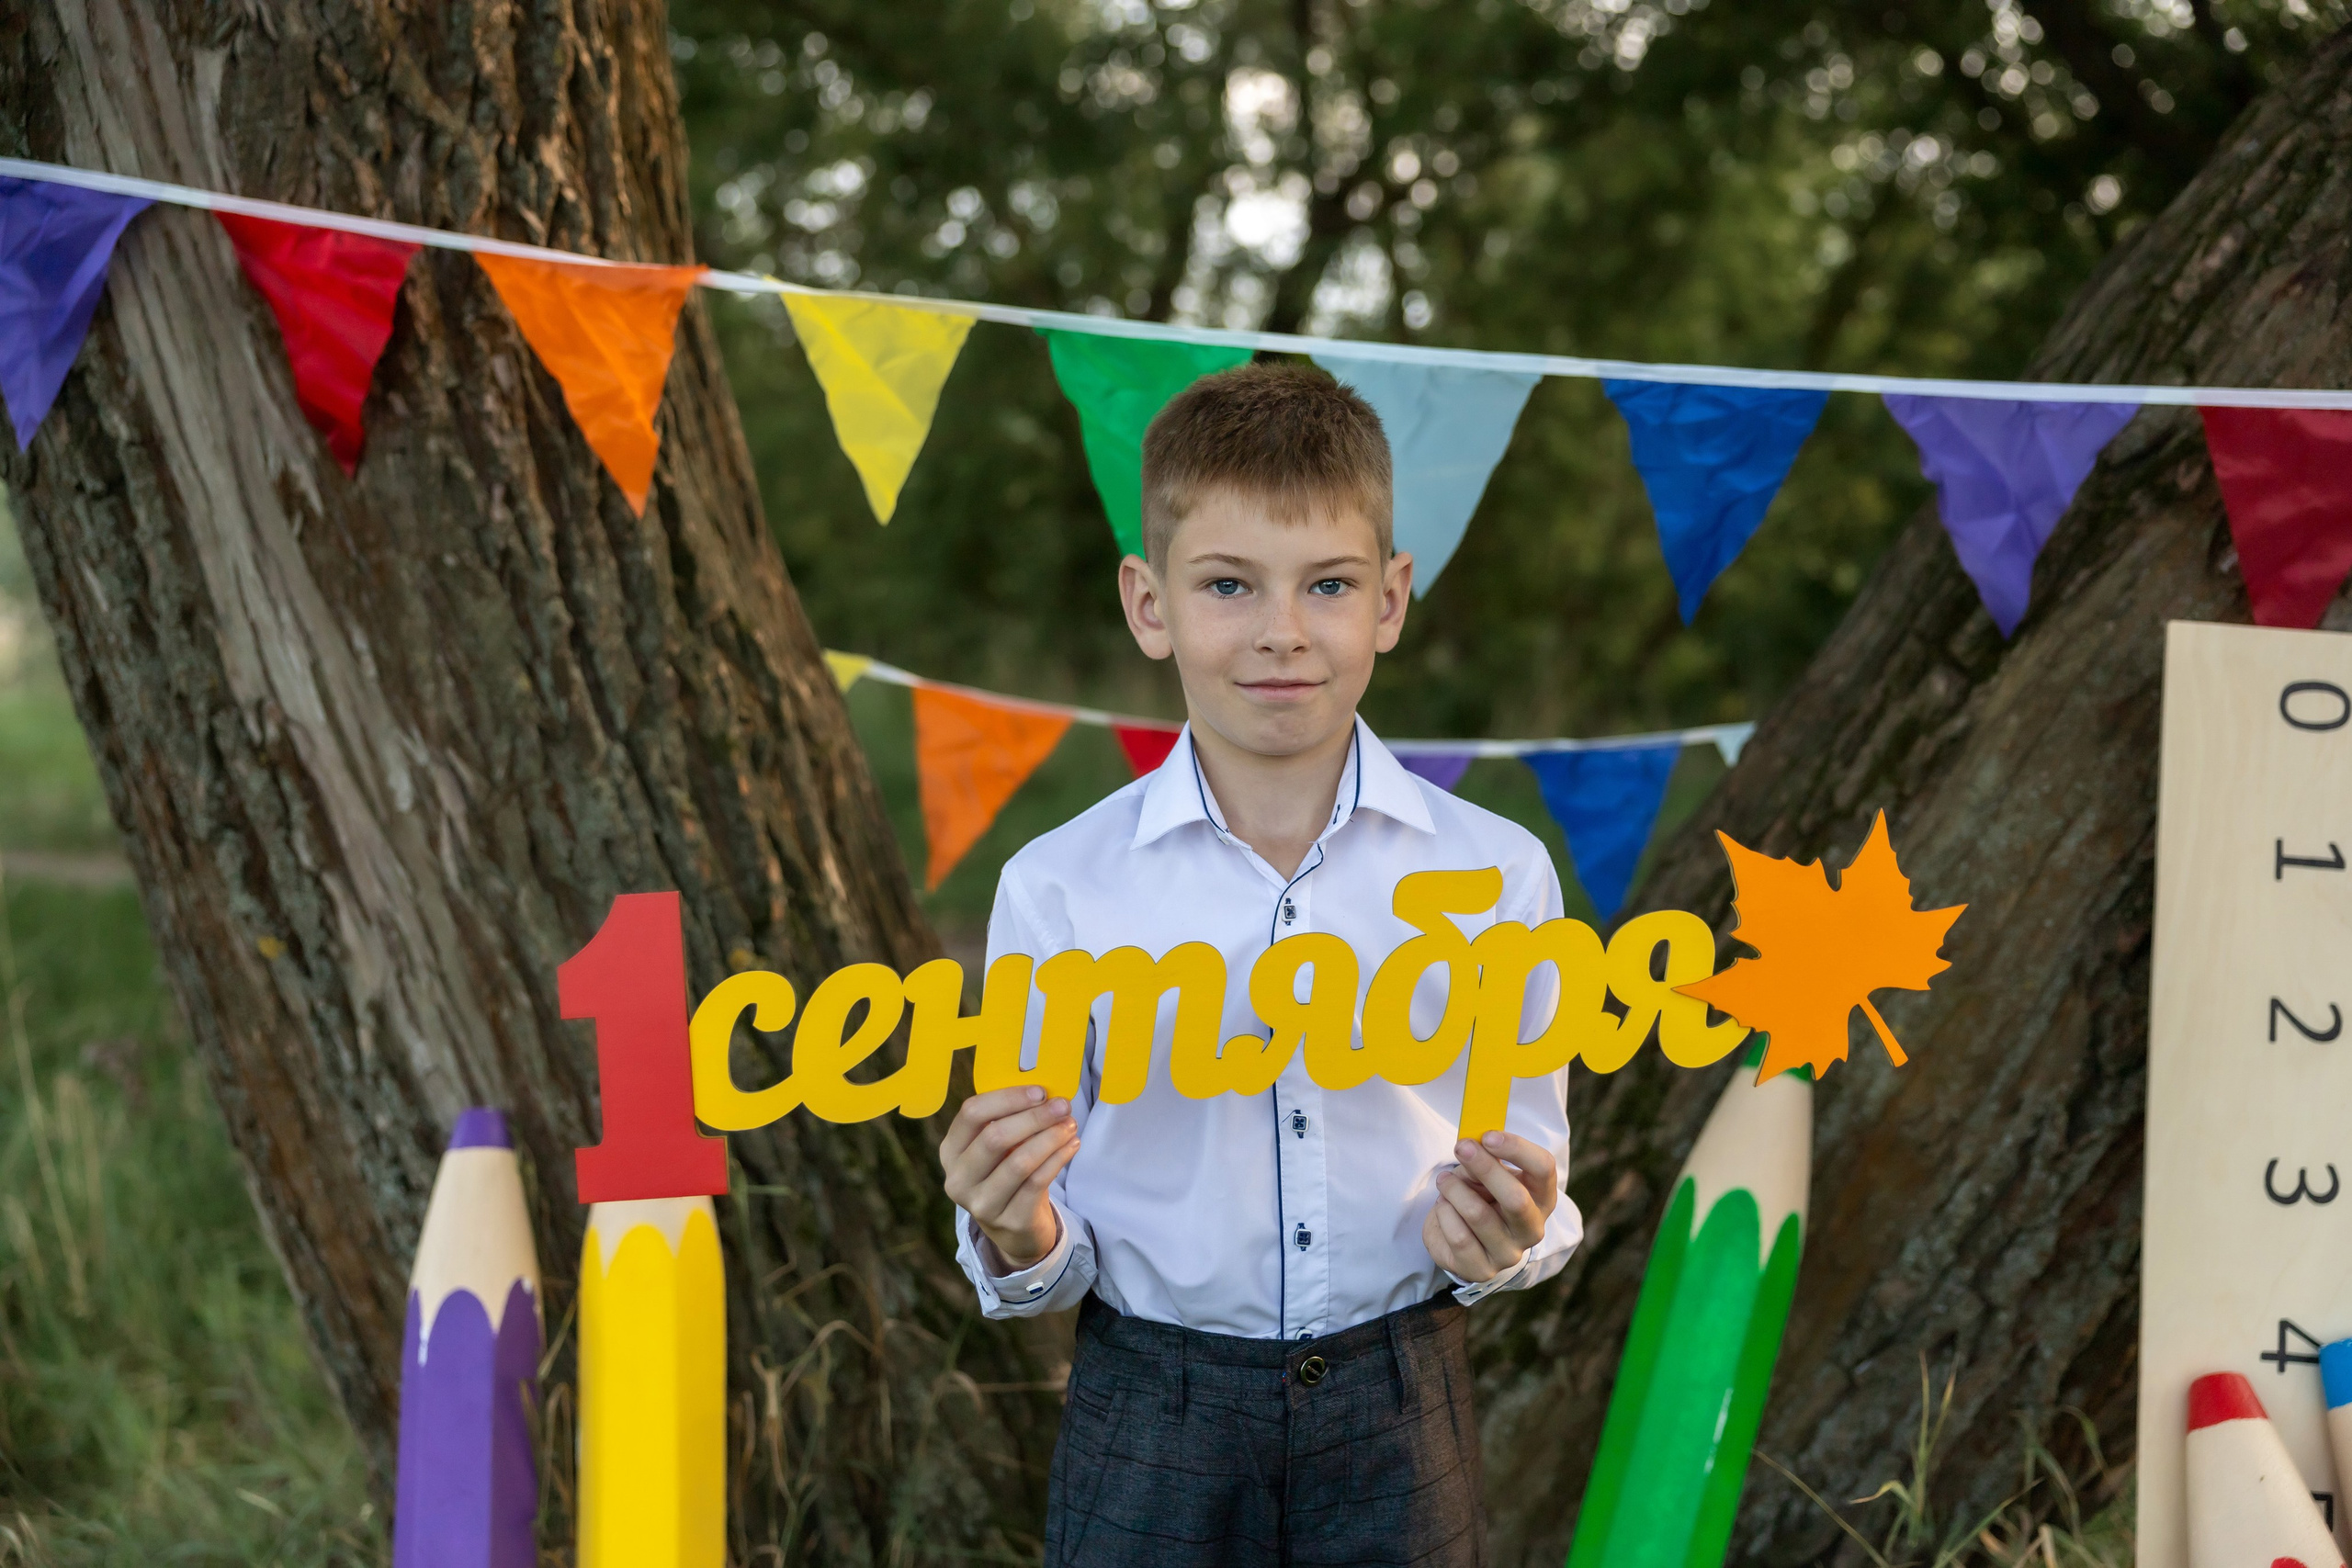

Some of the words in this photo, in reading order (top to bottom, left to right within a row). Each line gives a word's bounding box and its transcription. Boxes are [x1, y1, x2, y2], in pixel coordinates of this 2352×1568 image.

[2279, 681, 2352, 732] 0
[2275, 838, 2346, 881] 1
[558, 891, 729, 1204] 1
[689, 866, 1752, 1141] сентября
[2269, 998, 2343, 1043] 2
[2265, 1159, 2340, 1205] 3
[2260, 1318, 2320, 1373] 4
